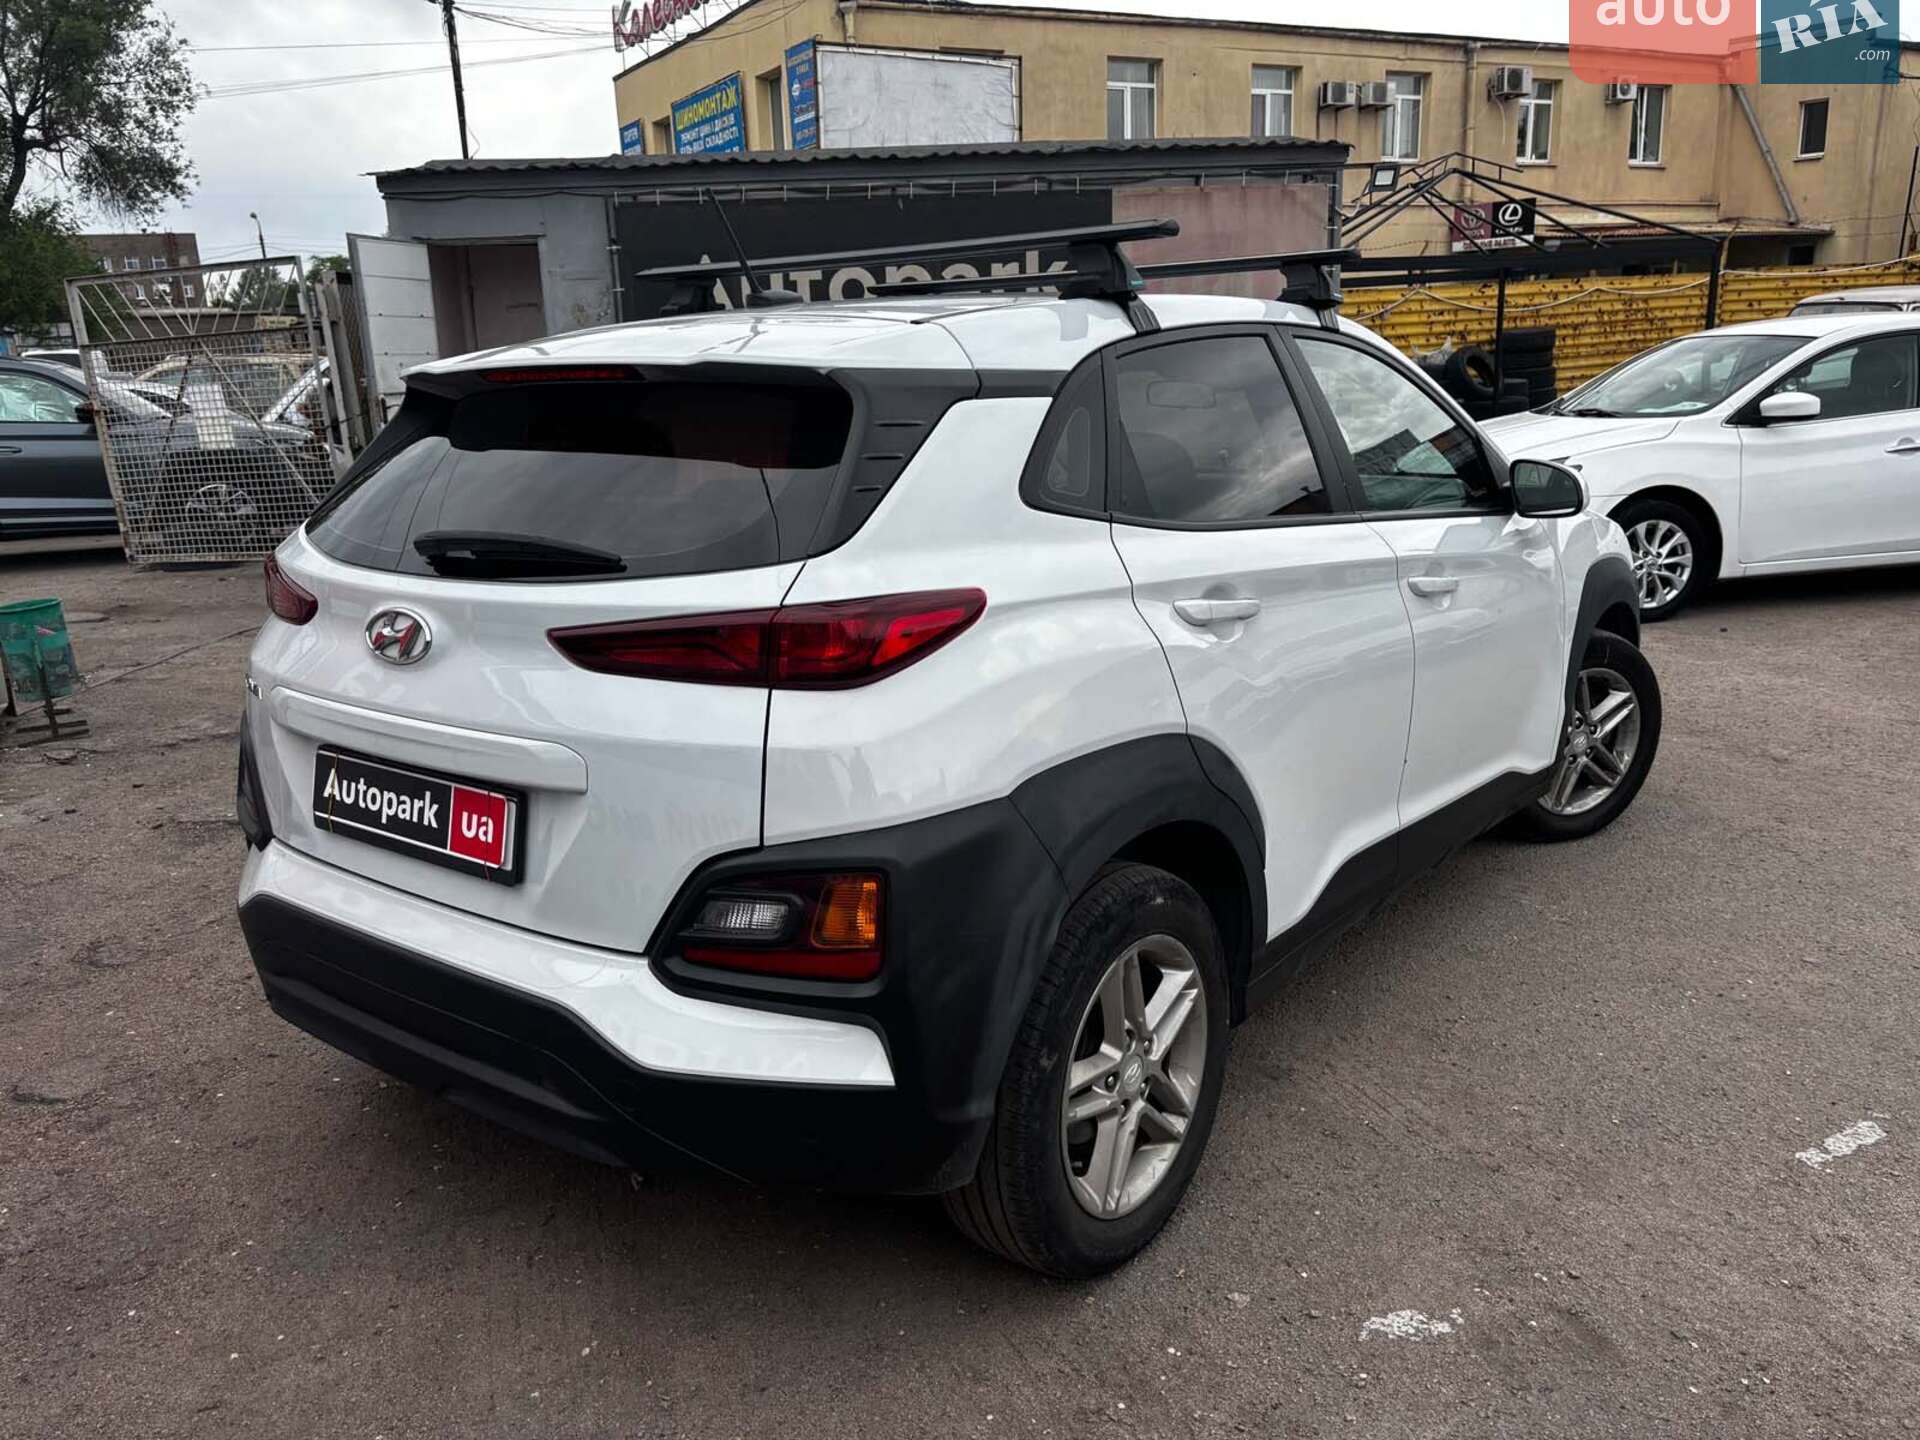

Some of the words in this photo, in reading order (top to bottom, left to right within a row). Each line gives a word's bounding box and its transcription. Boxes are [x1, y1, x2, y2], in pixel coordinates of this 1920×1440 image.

[675, 85, 738, 131] ШИНОМОНТАЖ
[323, 767, 439, 828] Autopark
[461, 810, 494, 843] ua
